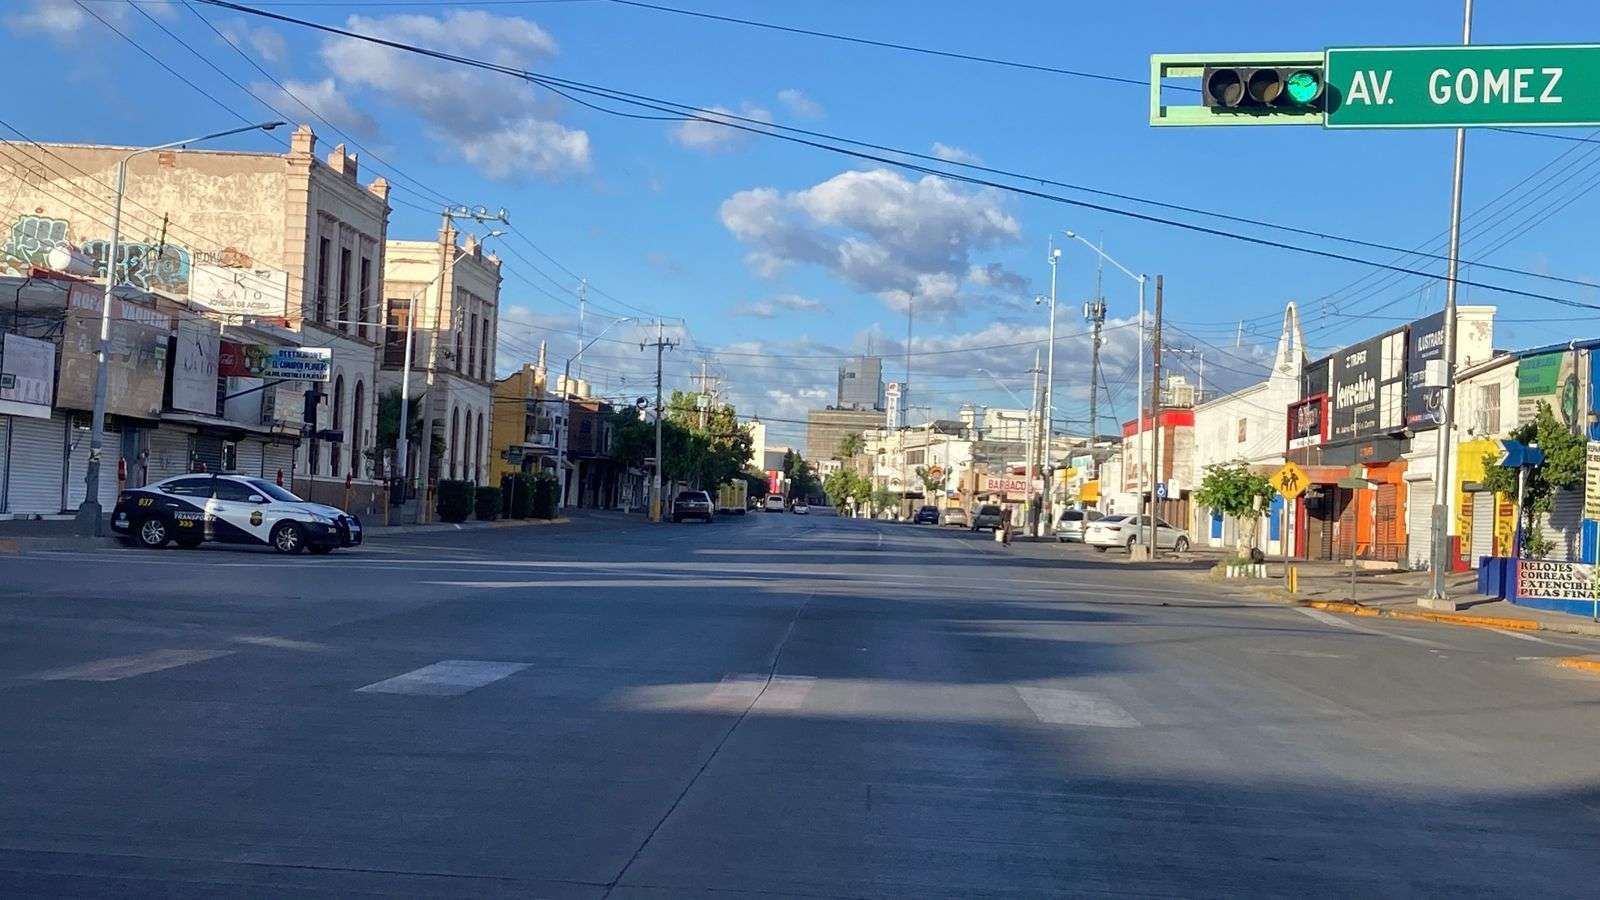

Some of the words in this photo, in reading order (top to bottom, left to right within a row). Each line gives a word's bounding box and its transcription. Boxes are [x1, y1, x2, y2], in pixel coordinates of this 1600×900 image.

[1345, 70, 1394, 105] AV.
[1428, 67, 1563, 105] GOMEZ
[174, 511, 217, 521] TRANSPORTE
[1520, 562, 1573, 573] RELOJES
[1520, 572, 1573, 581] CORREAS
[1520, 588, 1561, 598] PILAS
